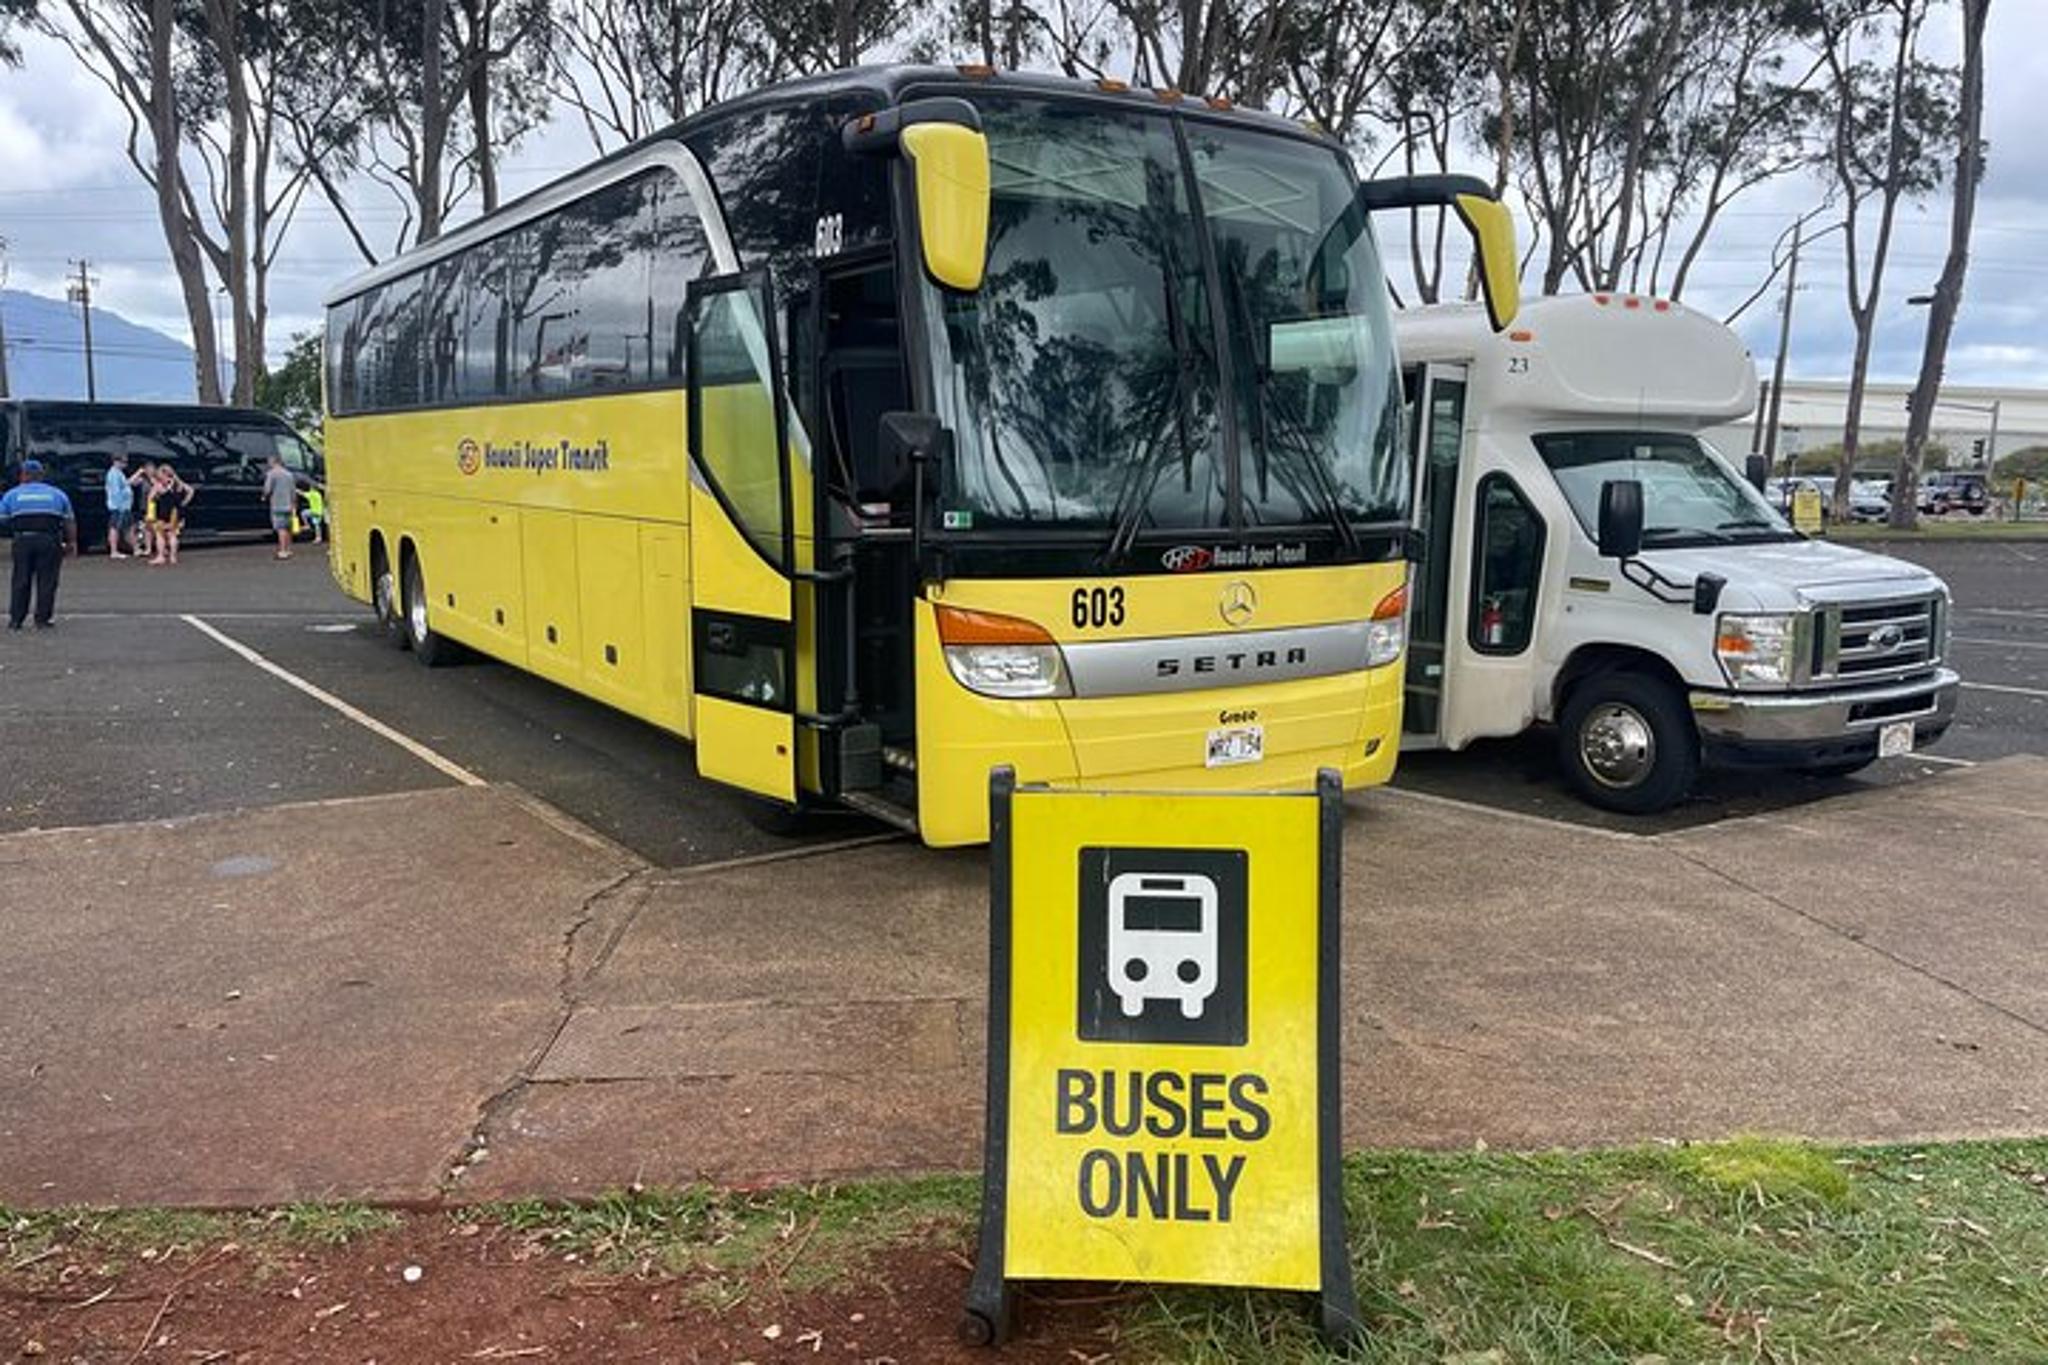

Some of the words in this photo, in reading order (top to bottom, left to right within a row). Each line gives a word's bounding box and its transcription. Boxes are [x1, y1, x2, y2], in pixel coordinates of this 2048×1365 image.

[815, 212, 843, 258] 603
[1507, 357, 1529, 374] 23
[560, 439, 610, 470] Transit
[1072, 586, 1125, 628] 603
[1157, 648, 1307, 677] SETRA
[1056, 1069, 1271, 1141] BUSES
[1079, 1149, 1246, 1222] ONLY
